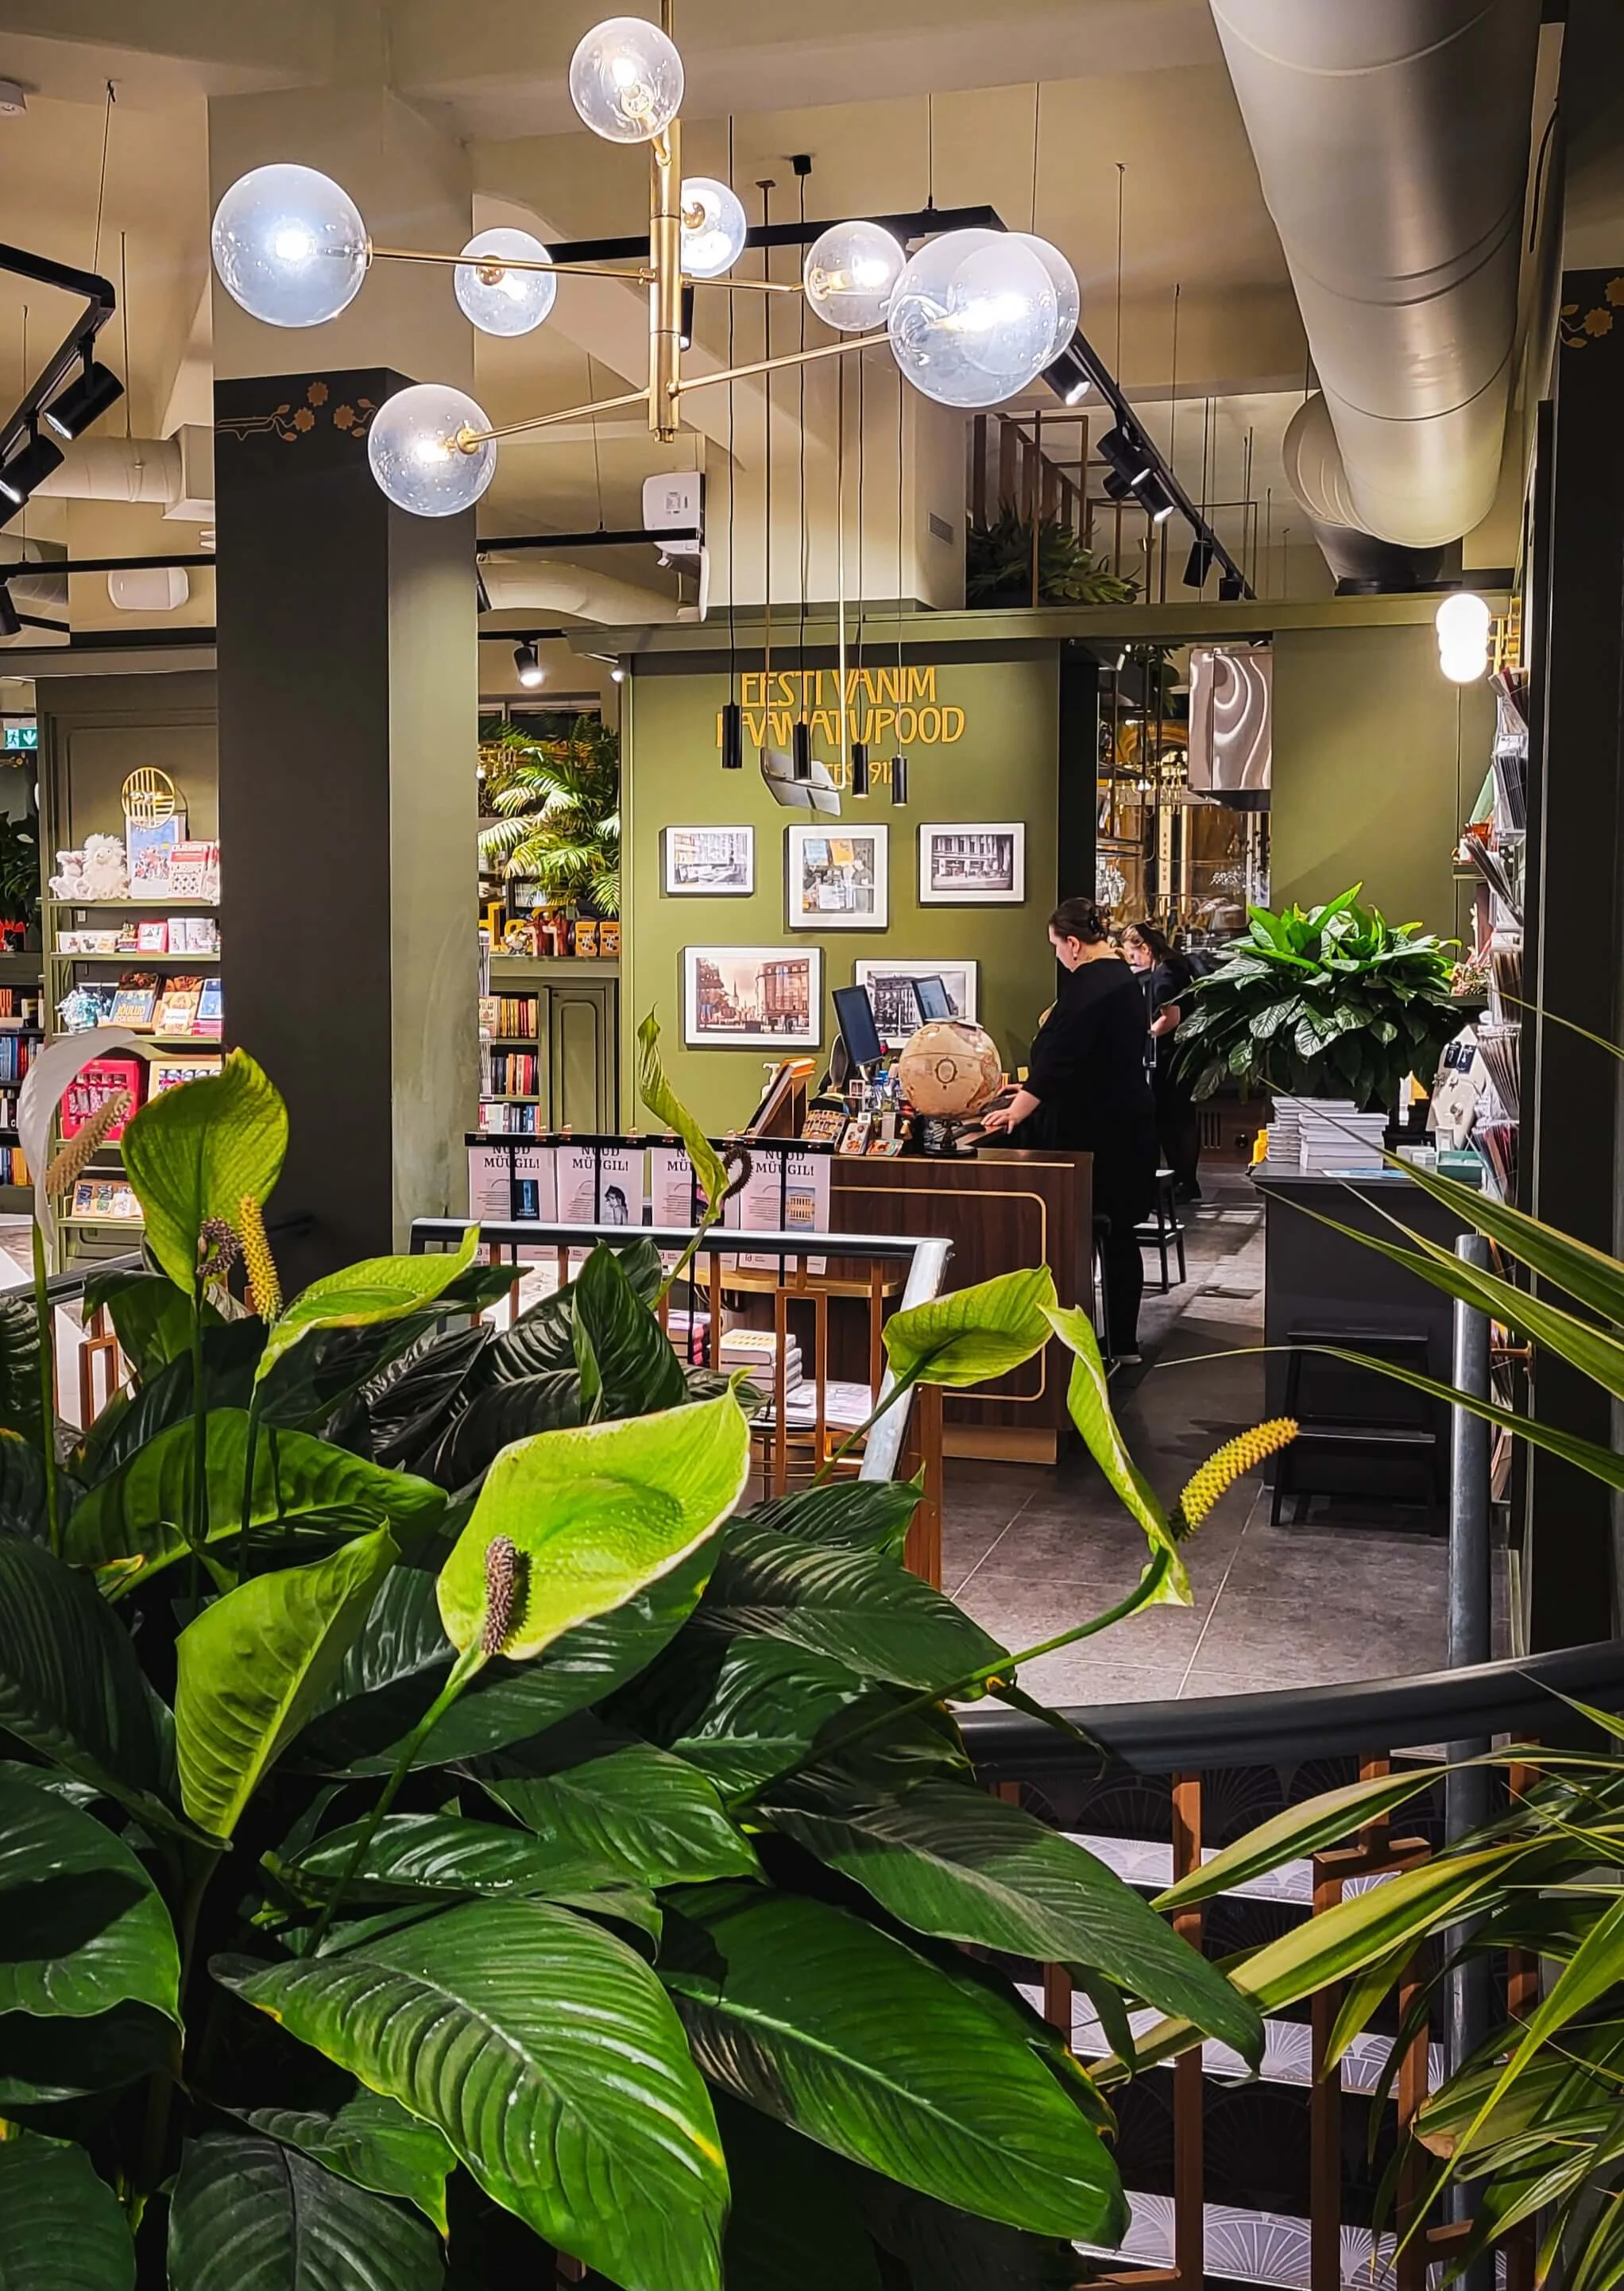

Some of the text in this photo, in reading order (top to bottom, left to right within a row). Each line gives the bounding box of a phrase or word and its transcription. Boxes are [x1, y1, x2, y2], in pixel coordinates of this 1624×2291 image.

[740, 667, 936, 707] EESTI VANIM
[572, 1156, 628, 1171] MÜGIL!
